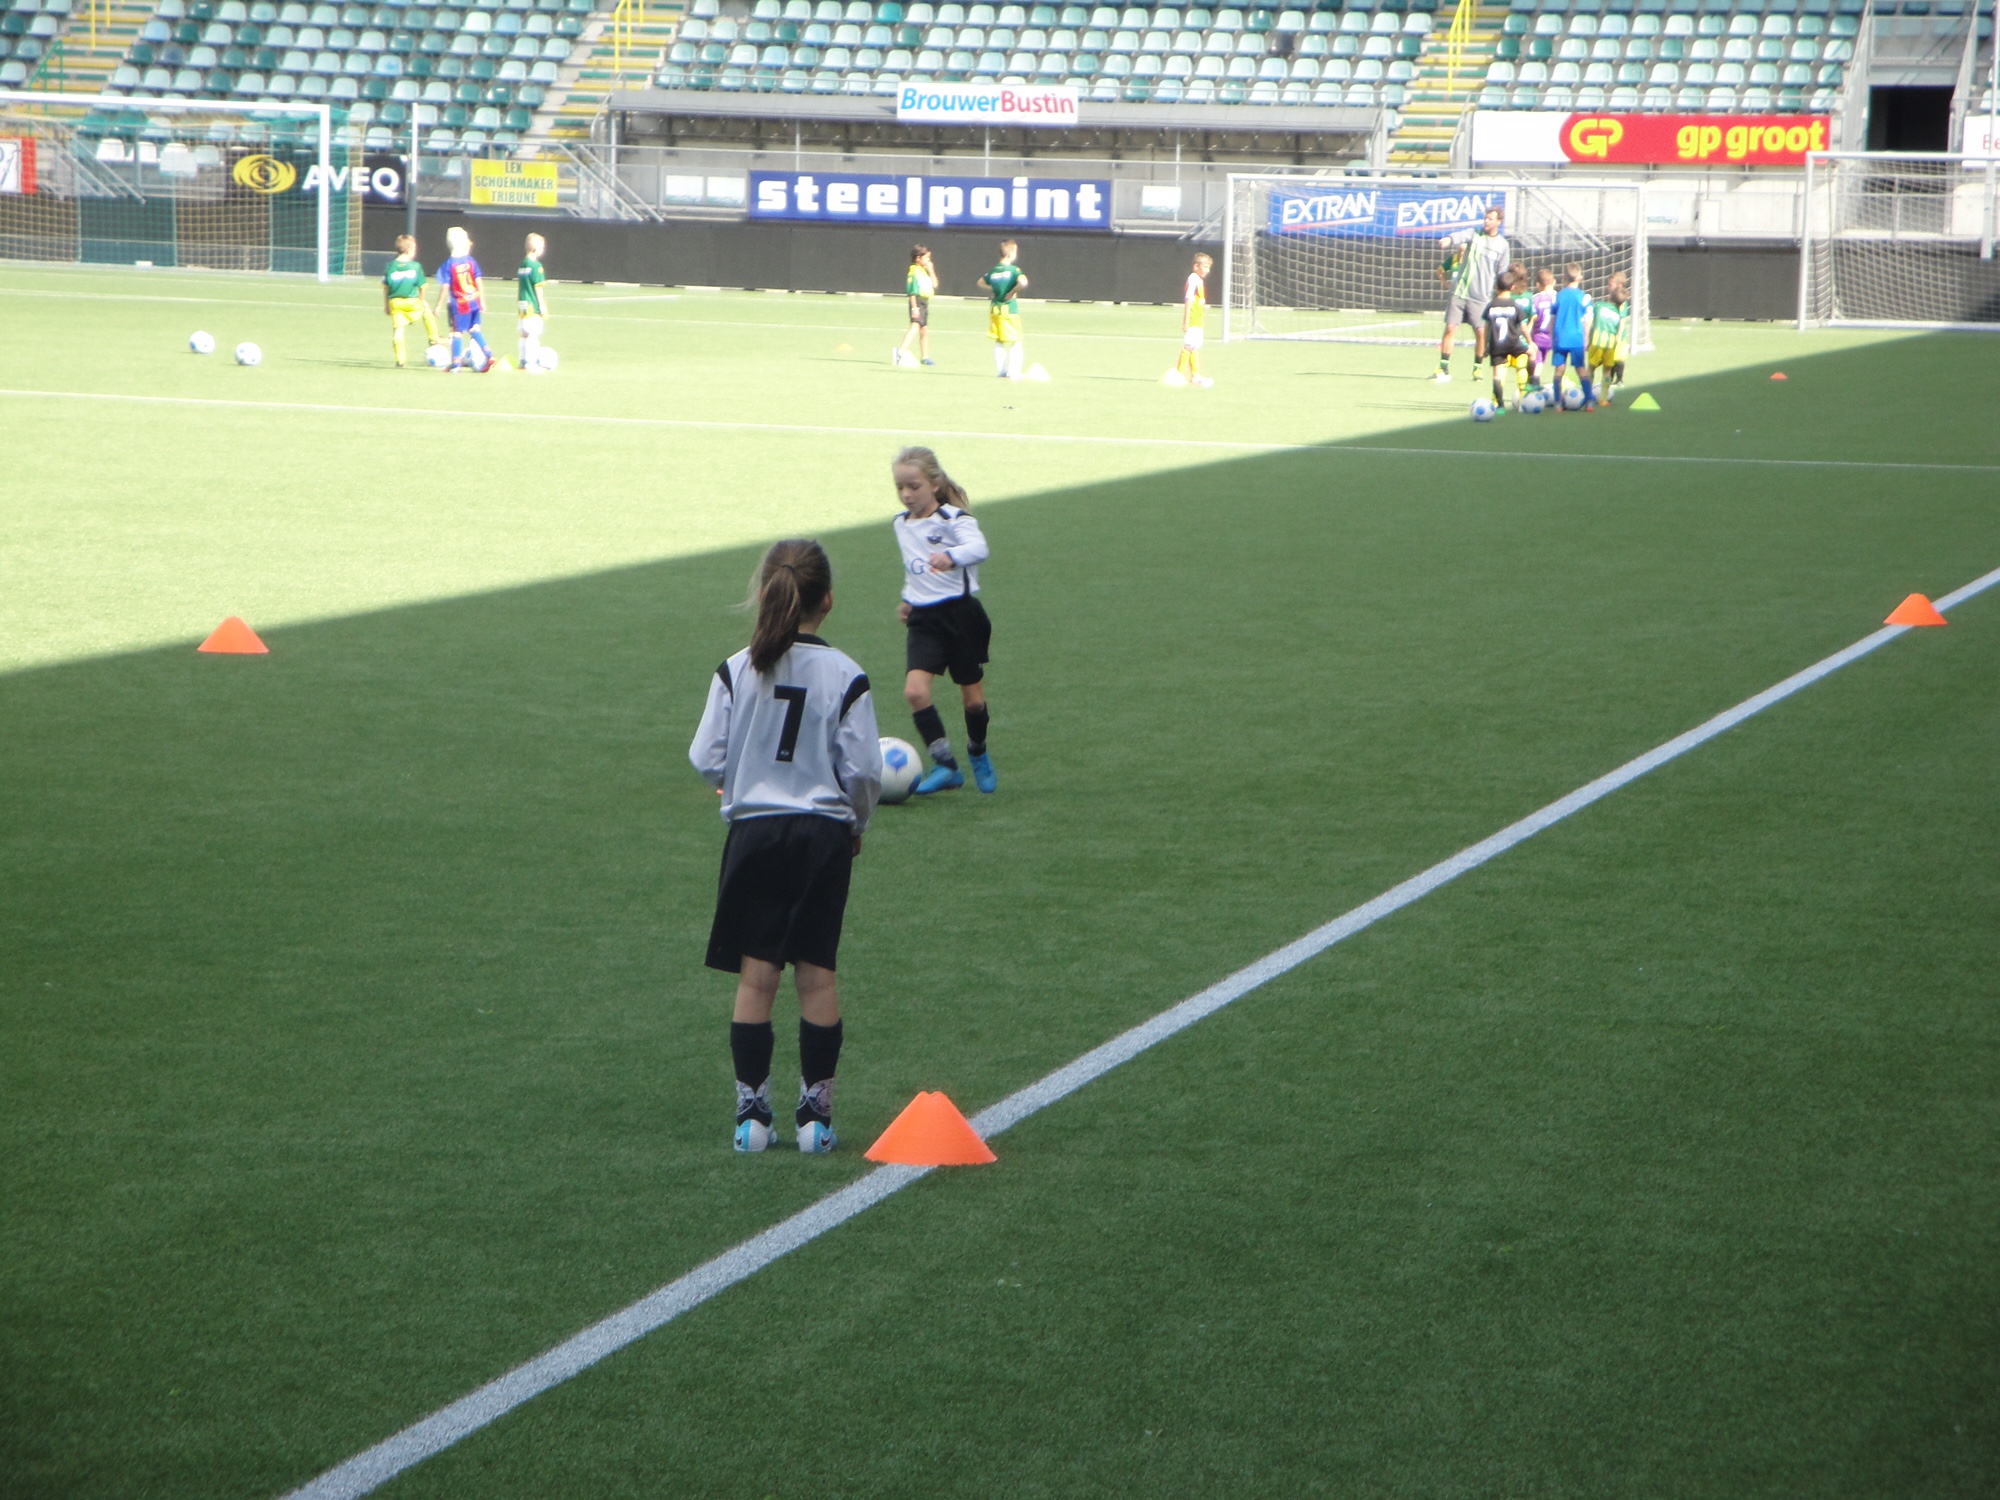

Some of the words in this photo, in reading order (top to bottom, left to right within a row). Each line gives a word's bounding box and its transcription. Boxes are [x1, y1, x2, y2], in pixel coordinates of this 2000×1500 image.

[900, 88, 1074, 113] BrouwerBustin
[1677, 126, 1721, 157] gp
[1727, 121, 1824, 158] groot
[302, 164, 400, 199] AVEQ
[475, 175, 553, 189] SCHOENMAKER
[505, 162, 522, 173] LEX
[491, 191, 536, 203] TRIBUNE
[758, 176, 1102, 224] steelpoint
[1283, 191, 1376, 224] EXTRAN
[1397, 193, 1492, 227] EXTRAN
[774, 685, 807, 762] 7
